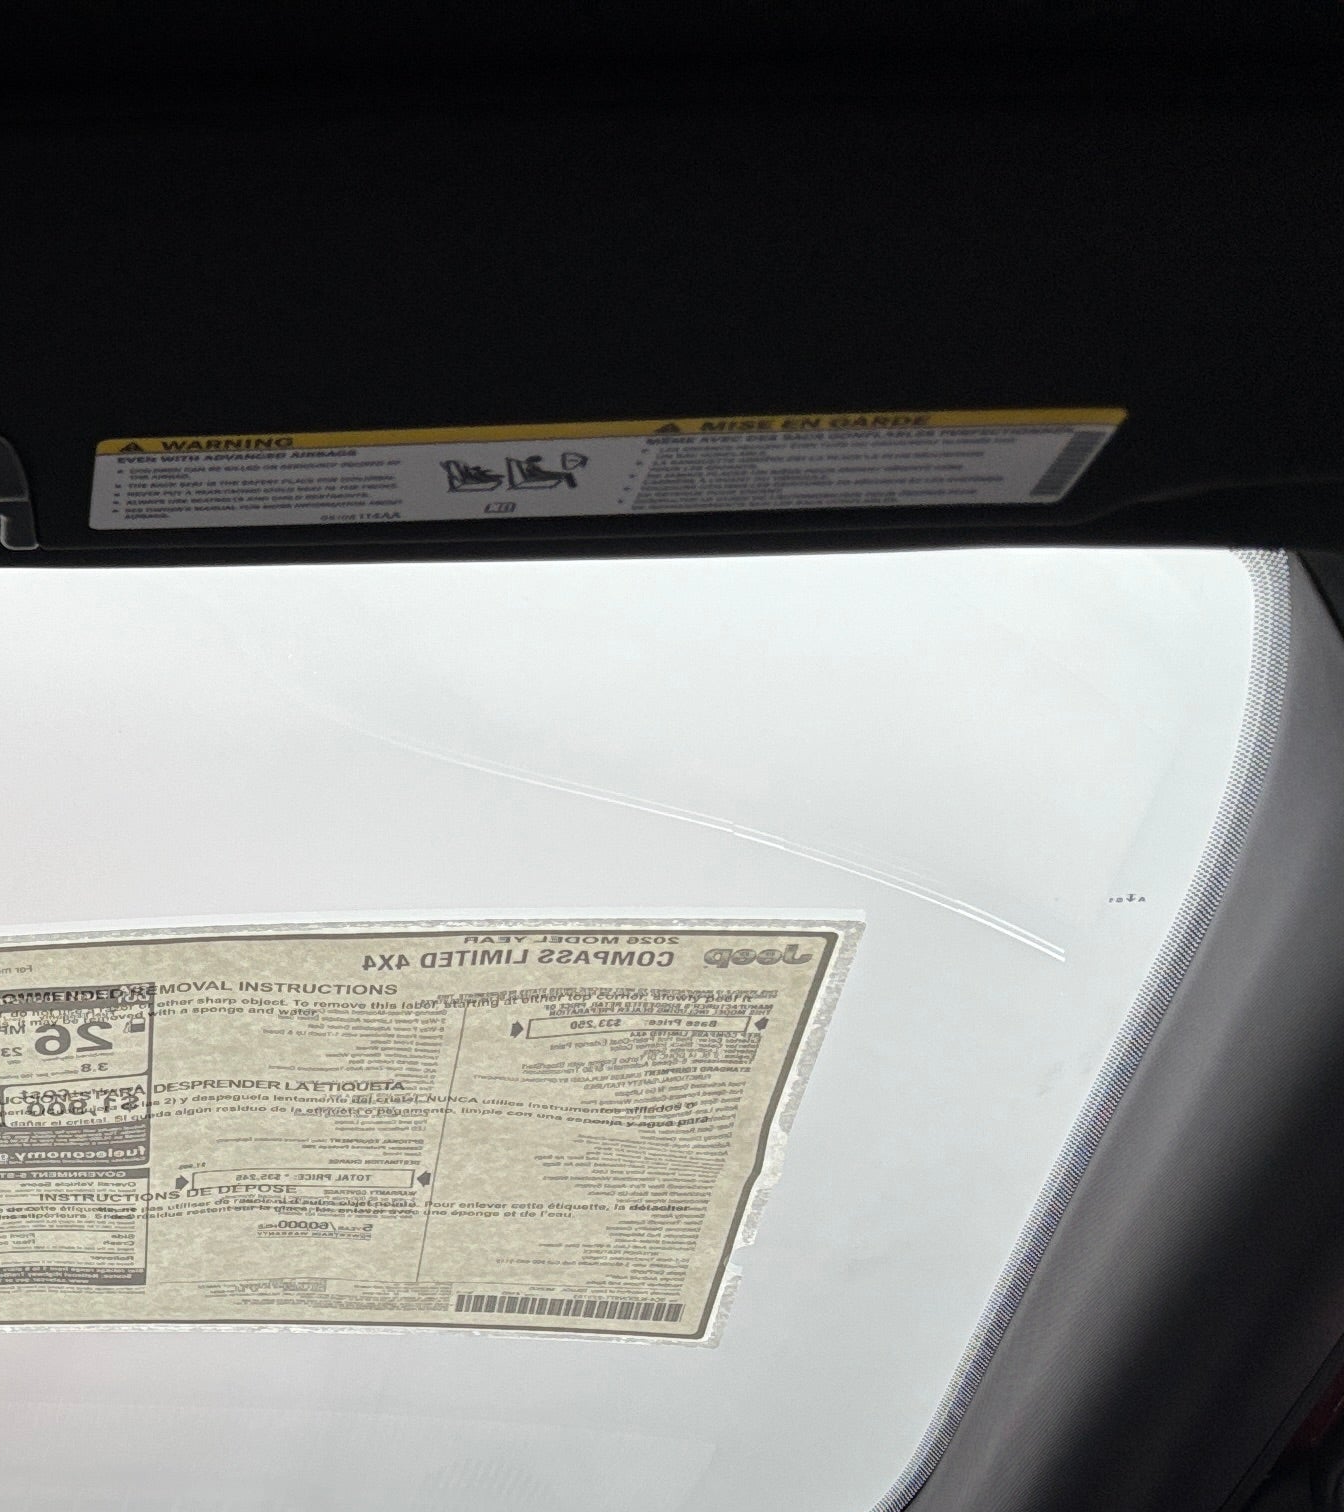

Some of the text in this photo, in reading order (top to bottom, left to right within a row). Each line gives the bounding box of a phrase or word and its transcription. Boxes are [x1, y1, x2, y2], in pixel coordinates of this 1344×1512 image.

[701, 415, 931, 431] MISE EN GARDE
[162, 437, 293, 451] WARNING
[239, 981, 398, 996] INSTRUCTIONS
